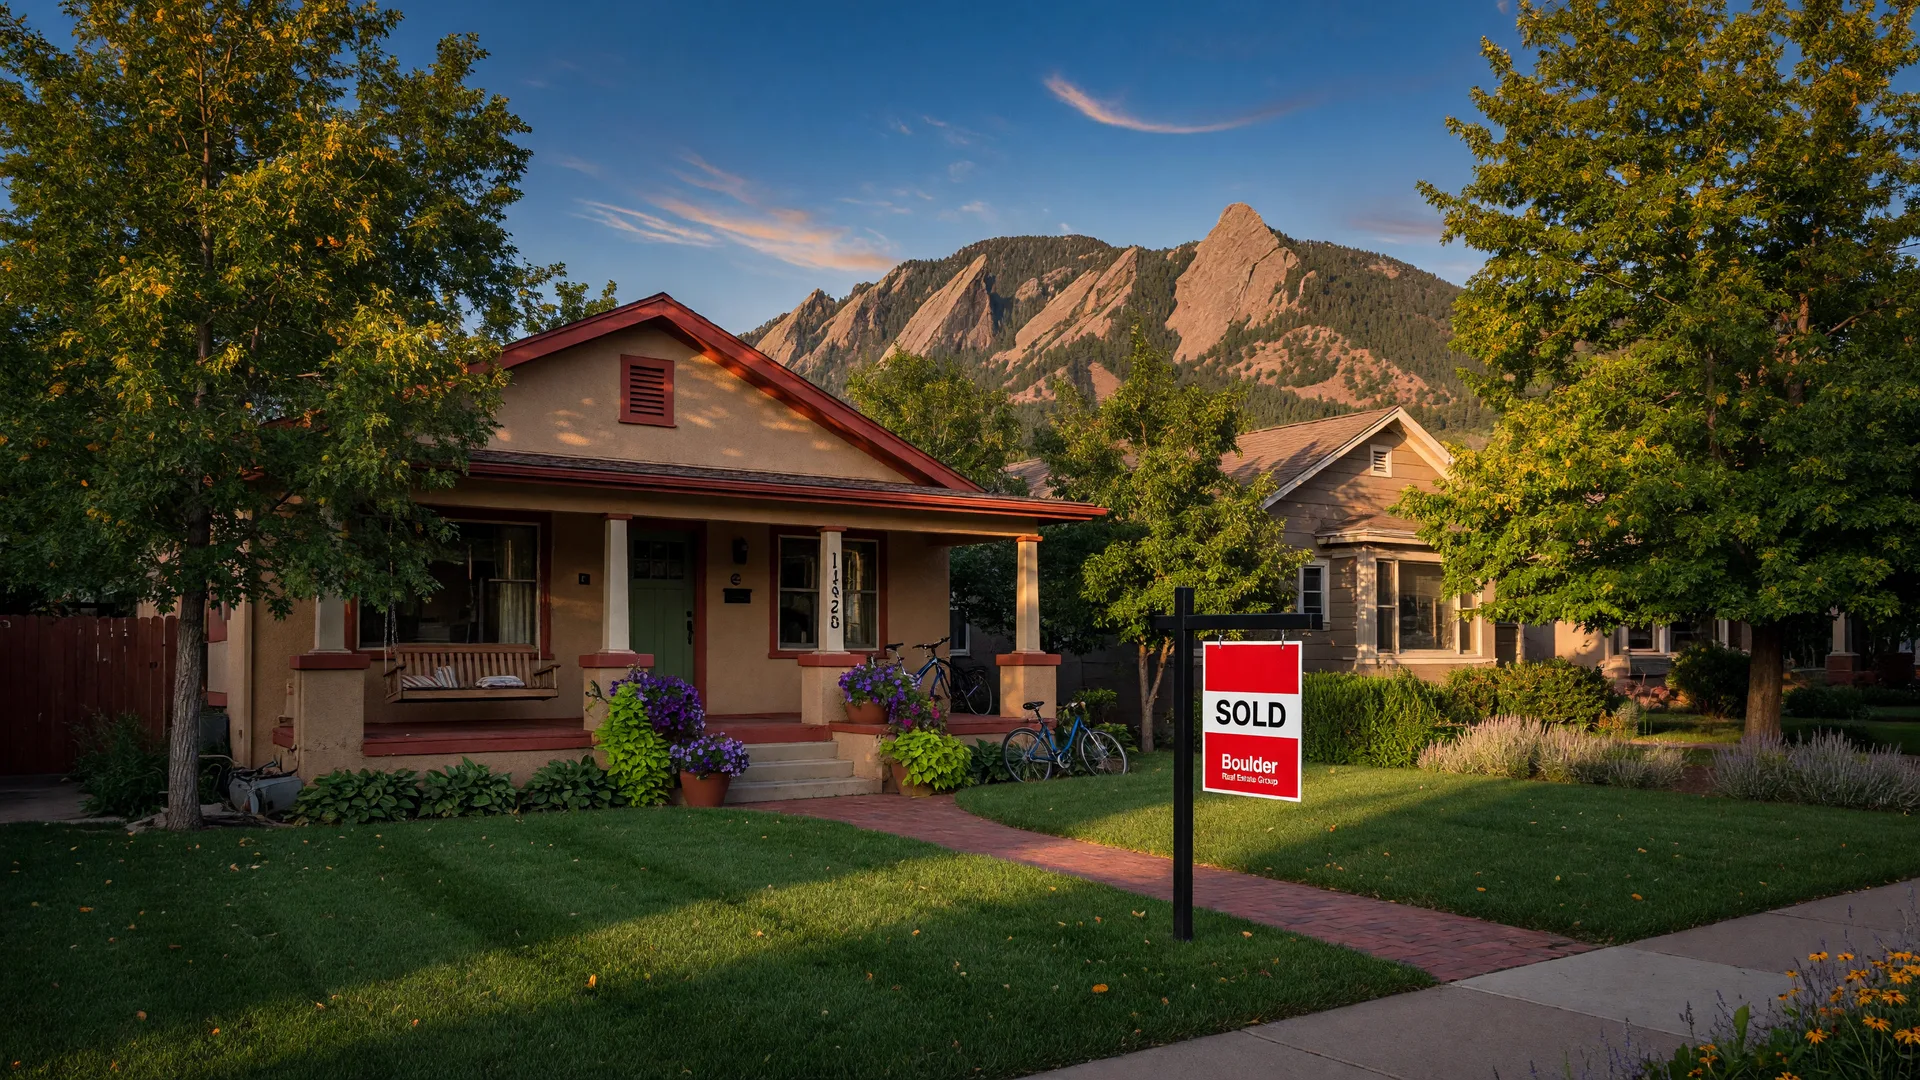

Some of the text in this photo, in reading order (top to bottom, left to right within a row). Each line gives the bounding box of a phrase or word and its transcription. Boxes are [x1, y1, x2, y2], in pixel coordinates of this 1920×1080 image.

[1215, 699, 1286, 728] SOLD
[1222, 753, 1278, 774] Boulder
[1221, 772, 1278, 786] Real Estate Group
